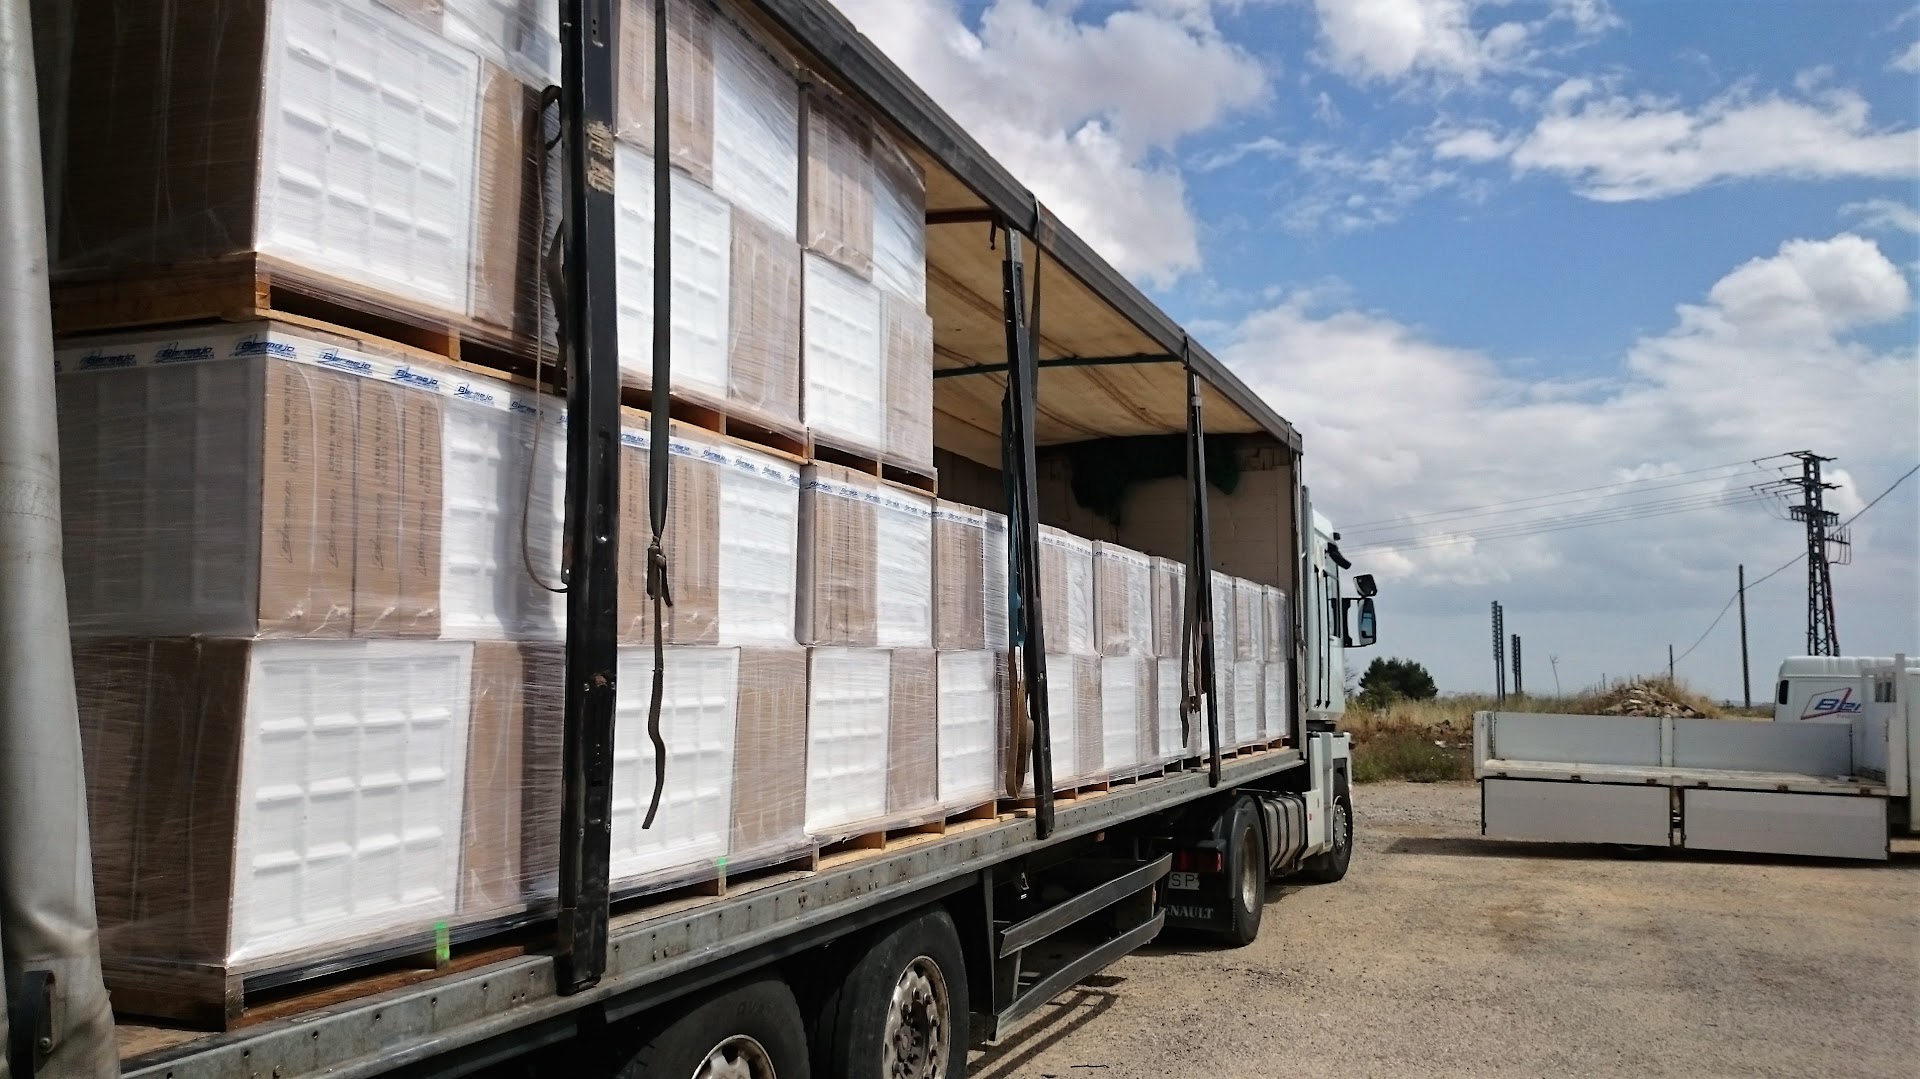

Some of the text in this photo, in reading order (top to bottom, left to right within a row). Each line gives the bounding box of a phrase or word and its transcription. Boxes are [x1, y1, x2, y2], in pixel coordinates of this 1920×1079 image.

[323, 352, 371, 369] Bermejo
[395, 369, 438, 385] Bermejo
[457, 386, 493, 401] Bermejo
[1171, 872, 1199, 888] SP
